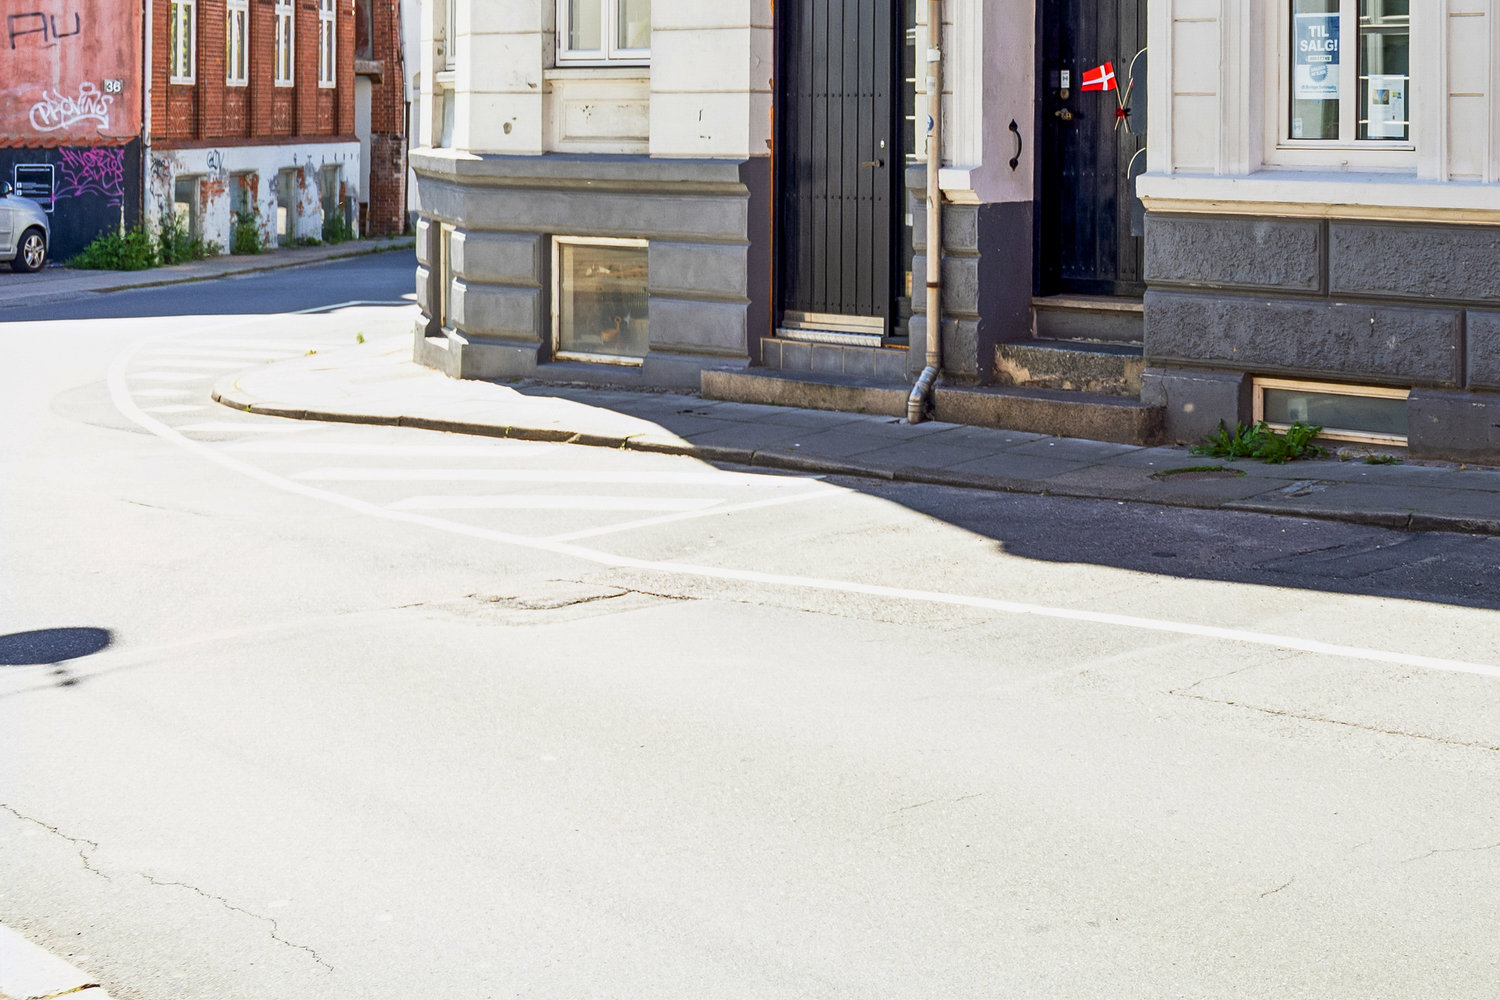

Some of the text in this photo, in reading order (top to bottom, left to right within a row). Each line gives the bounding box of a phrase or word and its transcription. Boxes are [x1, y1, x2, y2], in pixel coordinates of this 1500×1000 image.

[1308, 25, 1329, 38] TIL
[1300, 39, 1338, 52] SALG!
[105, 81, 121, 93] 36
